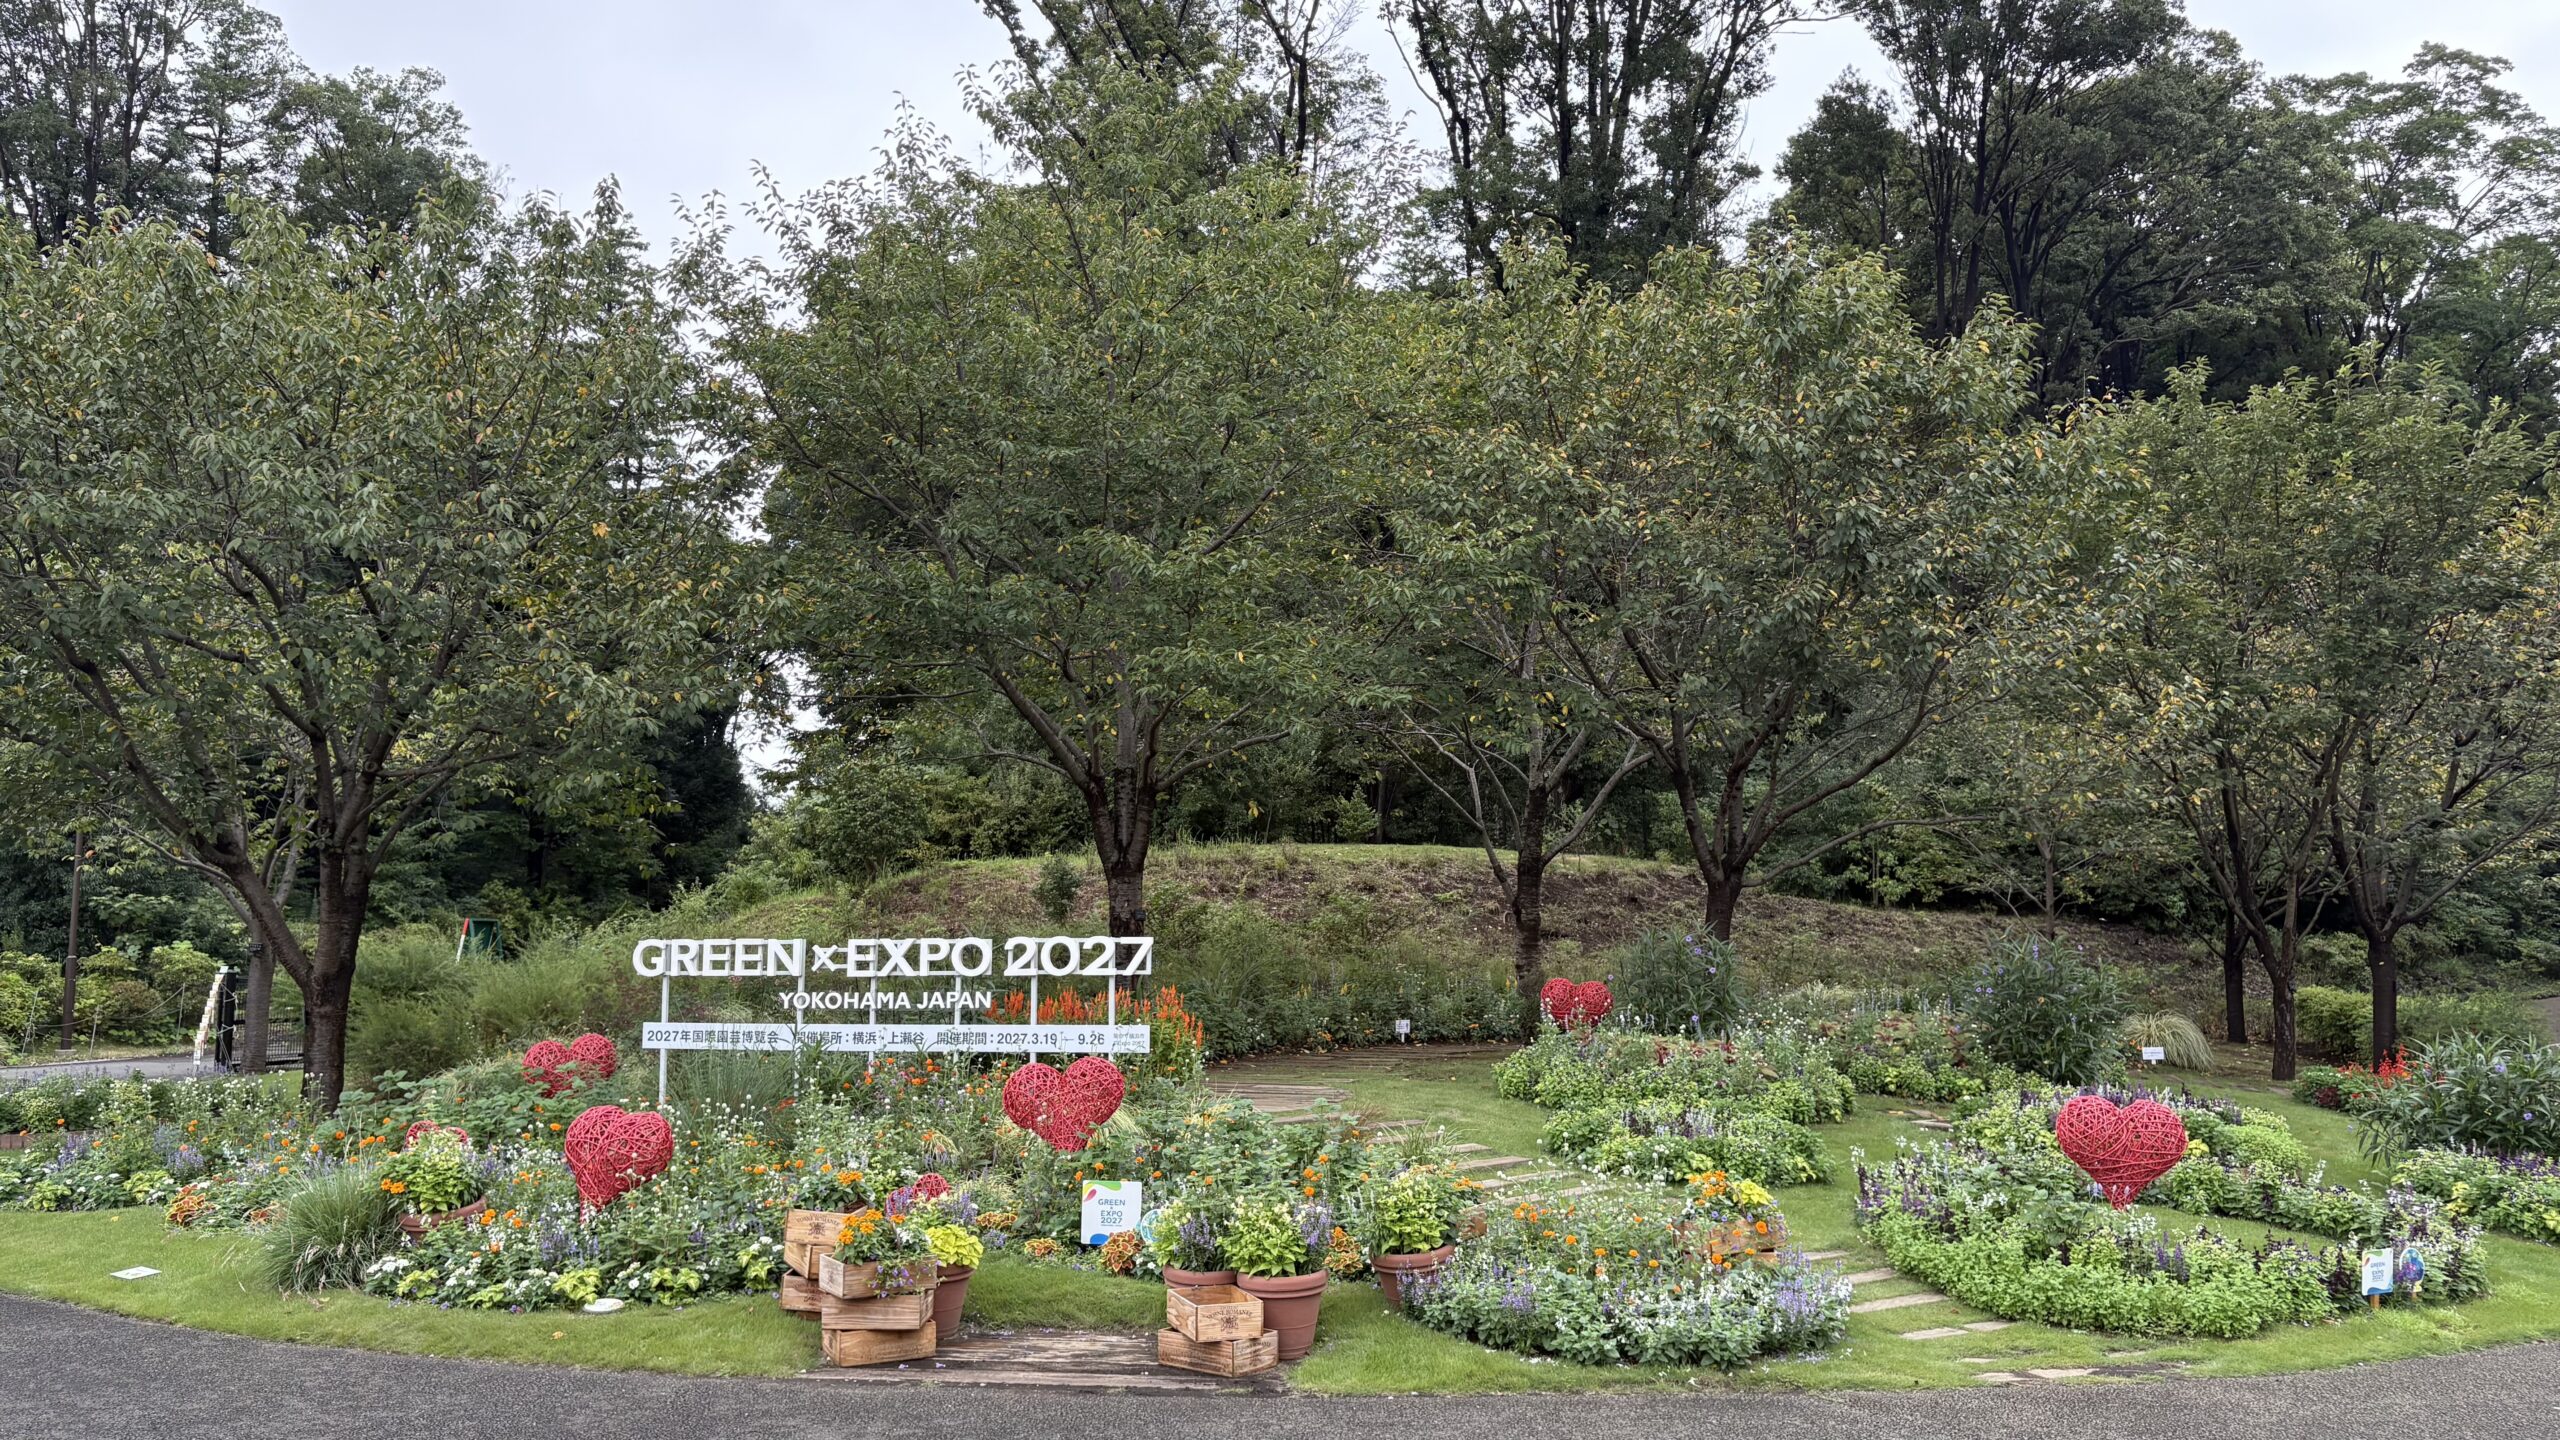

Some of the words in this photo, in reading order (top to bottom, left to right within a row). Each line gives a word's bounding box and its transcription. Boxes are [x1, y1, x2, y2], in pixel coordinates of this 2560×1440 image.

[632, 938, 803, 977] GREEN
[847, 937, 991, 977] EXPO
[1003, 936, 1154, 977] 2027
[778, 991, 911, 1010] YOKOHAMA
[916, 991, 992, 1010] JAPAN
[1077, 1033, 1105, 1045] 9.26
[1097, 1198, 1126, 1206] GREEN
[1100, 1210, 1123, 1218] EXPO
[1100, 1216, 1123, 1224] 2027
